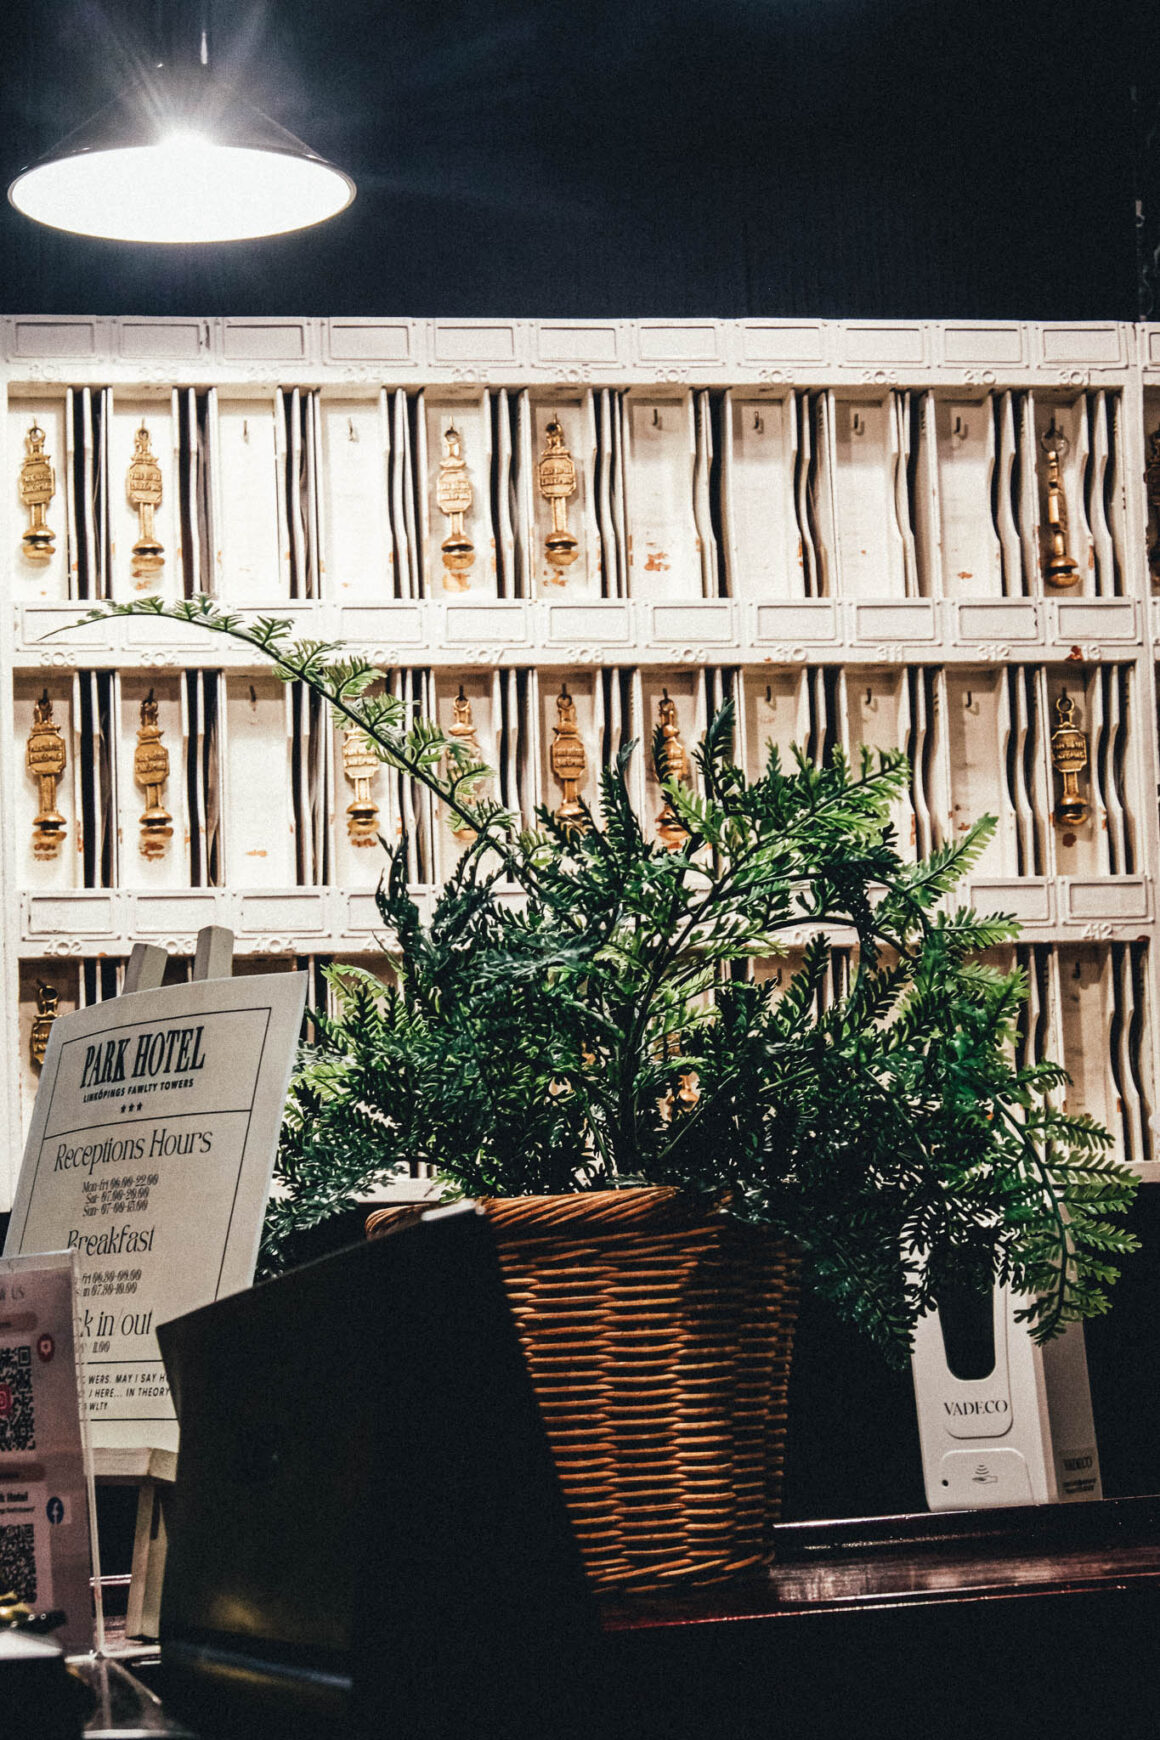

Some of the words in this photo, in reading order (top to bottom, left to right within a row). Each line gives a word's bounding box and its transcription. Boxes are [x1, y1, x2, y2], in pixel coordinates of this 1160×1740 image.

[876, 645, 904, 663] 311
[977, 645, 1012, 662] 312
[1083, 922, 1113, 941] 412
[79, 1037, 131, 1089] PARK
[131, 1025, 206, 1078] HOTEL
[127, 1083, 159, 1095] FAWLTY
[160, 1078, 194, 1092] TOWERS
[54, 1137, 145, 1175] Receptions
[150, 1128, 213, 1158] Hours
[68, 1224, 156, 1256] Breakfast
[115, 1373, 132, 1383] MAY
[141, 1373, 157, 1383] SAY
[126, 1388, 135, 1397] IN
[138, 1386, 170, 1397] THEORY
[944, 1399, 1008, 1416] VADECO
